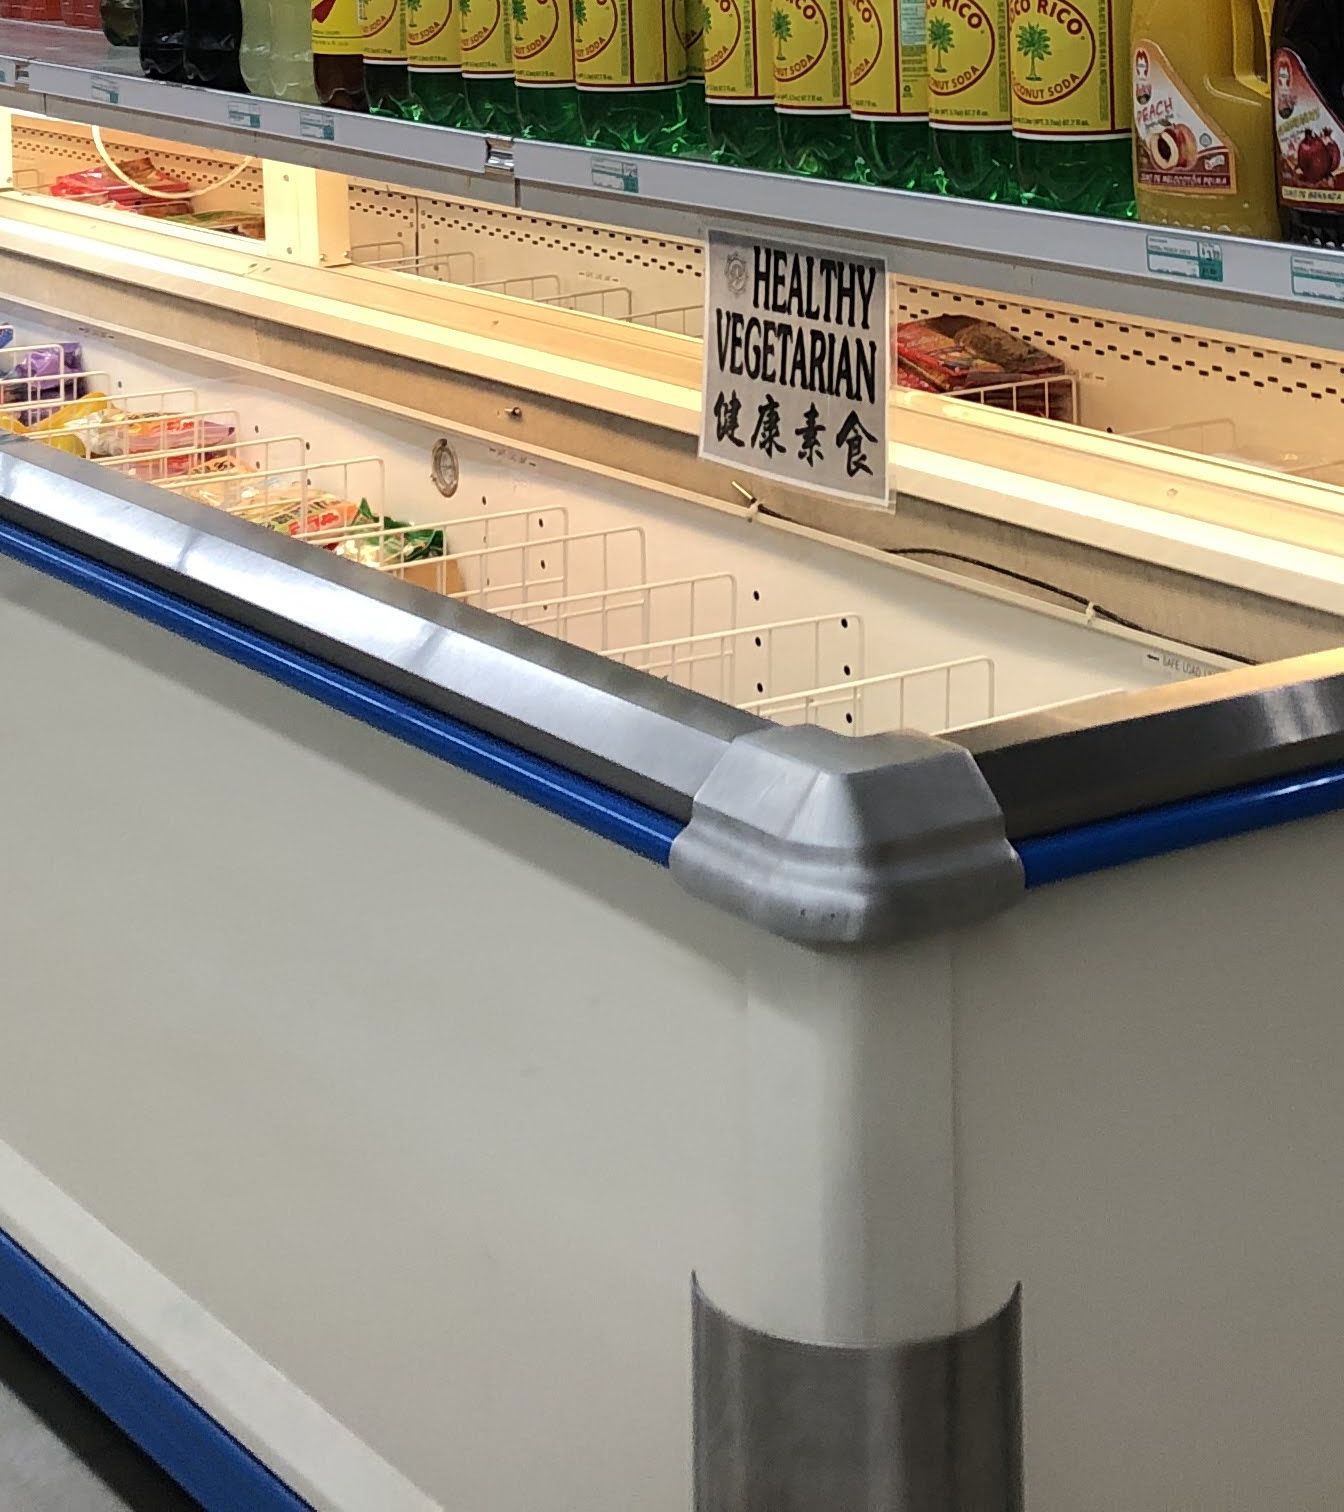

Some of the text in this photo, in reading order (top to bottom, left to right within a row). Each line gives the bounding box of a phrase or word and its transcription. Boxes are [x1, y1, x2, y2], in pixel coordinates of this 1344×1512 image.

[420, 21, 440, 39] SODA
[470, 26, 490, 45] SODA
[526, 34, 547, 51] SODA
[585, 36, 606, 56] SODA
[710, 45, 729, 65] SODA
[789, 53, 815, 74] SODA
[952, 65, 980, 88] SODA
[1048, 72, 1080, 97] SODA
[753, 245, 877, 330] HEALTHY
[715, 307, 878, 405] VEGETARIAN
[713, 388, 879, 478] 健康素食
